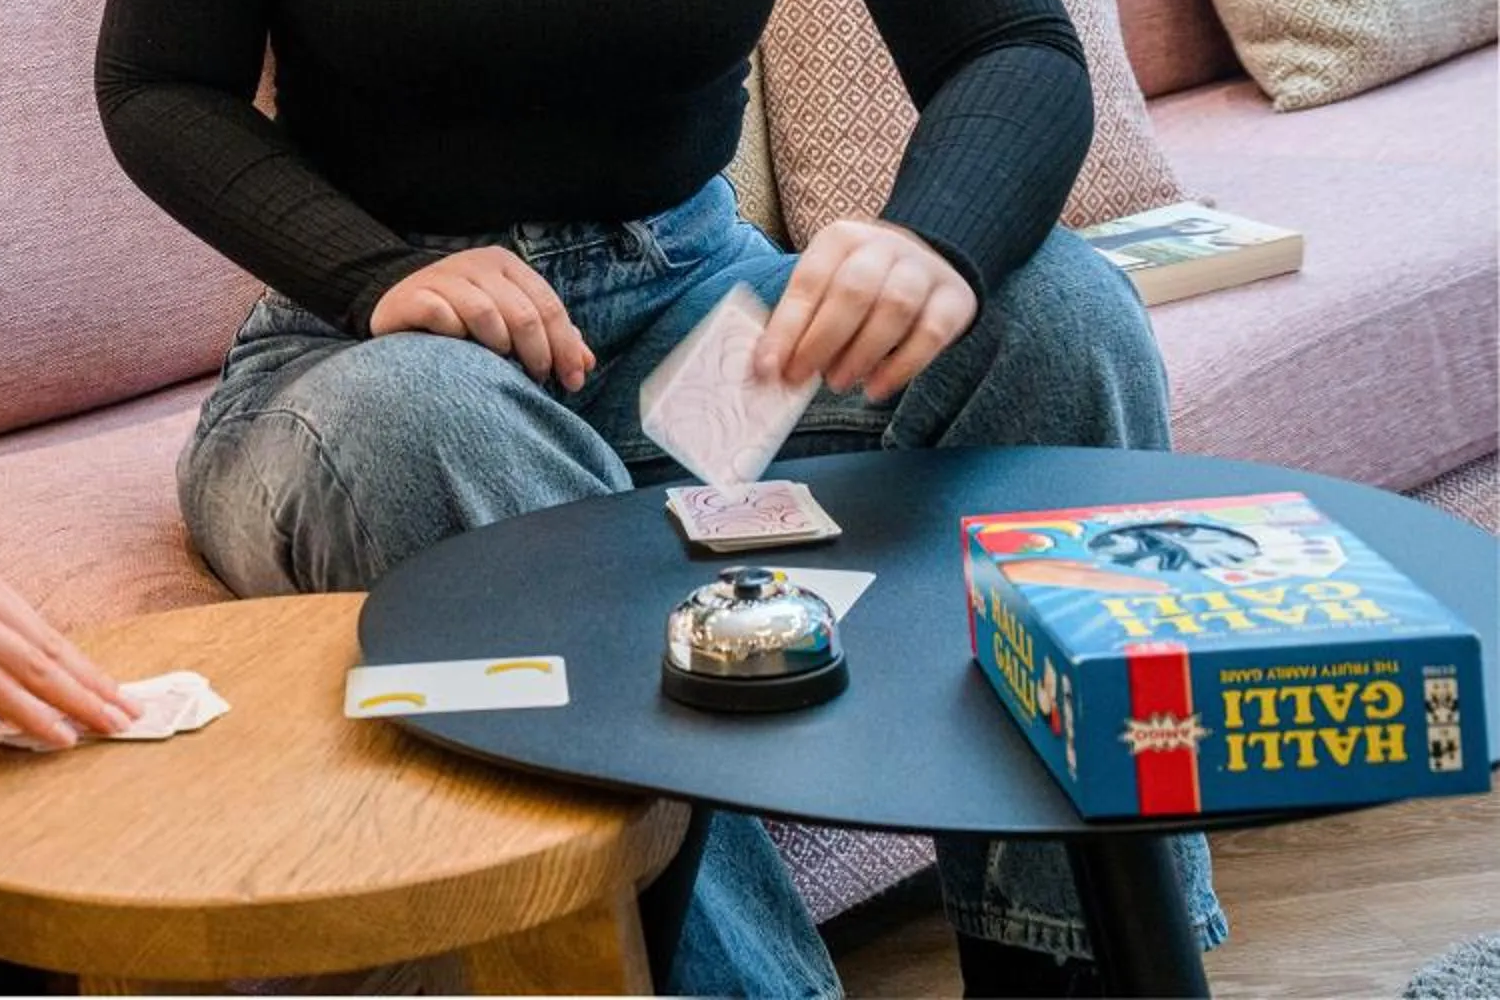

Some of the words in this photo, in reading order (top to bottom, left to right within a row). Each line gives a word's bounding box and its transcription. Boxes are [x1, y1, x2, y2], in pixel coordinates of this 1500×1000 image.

[1101, 581, 1362, 618] GALLI
[1124, 599, 1392, 637] HALLI
[991, 586, 1034, 674] HALLI
[993, 631, 1037, 719] GALLI
[1219, 668, 1263, 684] GAME
[1267, 664, 1317, 681] FAMILY
[1321, 661, 1370, 678] FRUITY
[1374, 659, 1400, 674] THE
[1221, 679, 1405, 729] GALLI
[1134, 727, 1190, 741] AMIGO
[1225, 723, 1409, 772] HALLI
